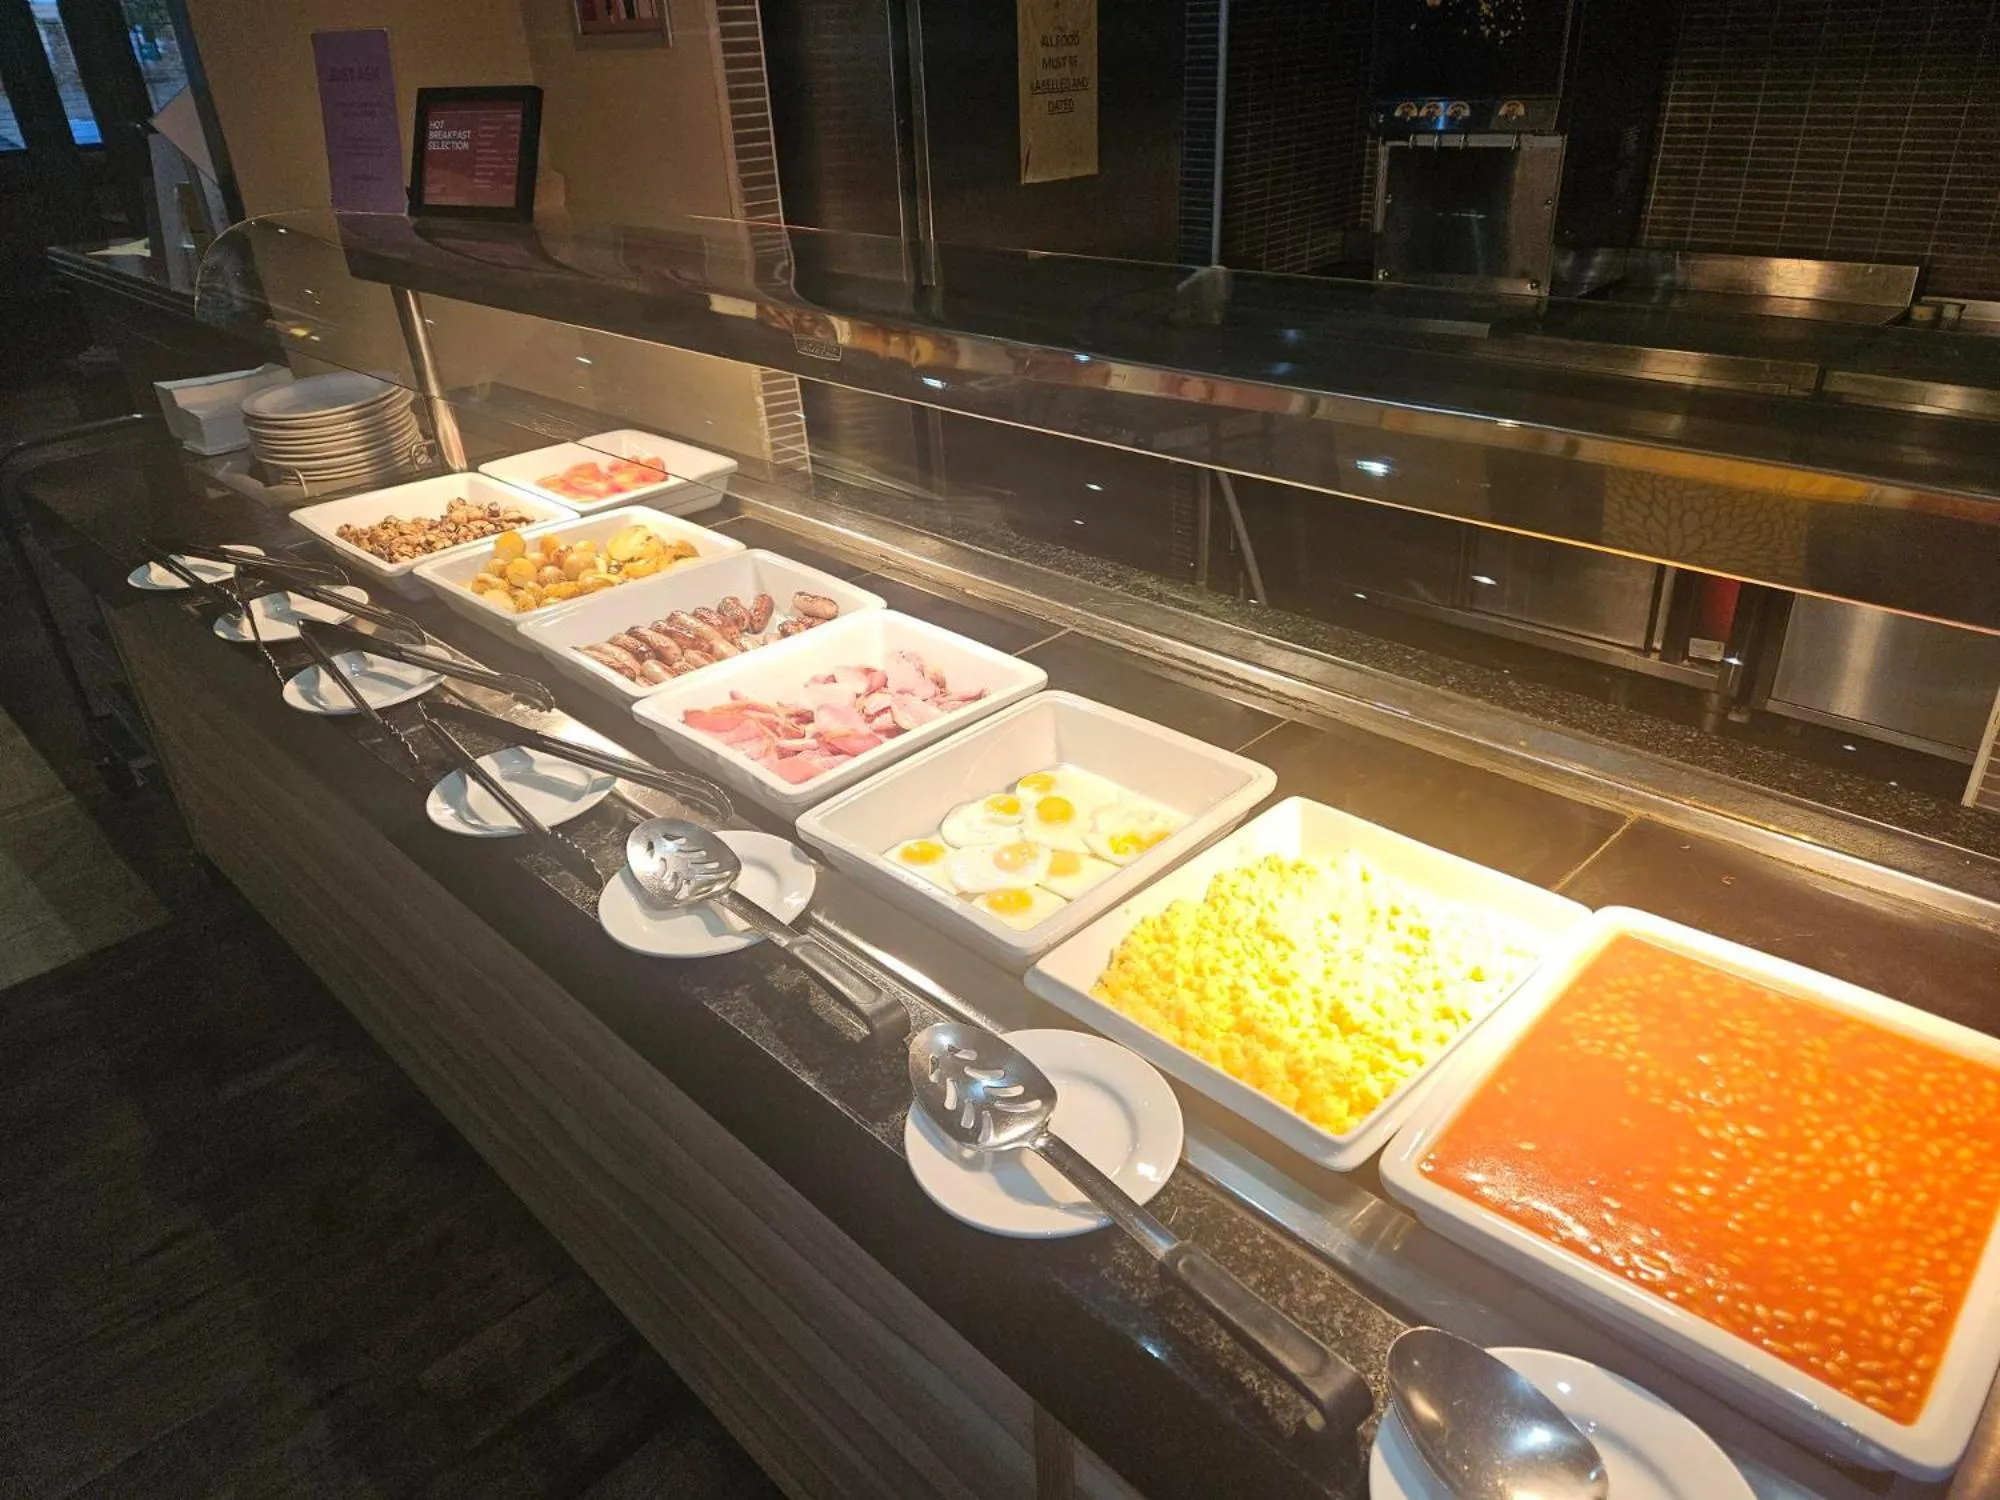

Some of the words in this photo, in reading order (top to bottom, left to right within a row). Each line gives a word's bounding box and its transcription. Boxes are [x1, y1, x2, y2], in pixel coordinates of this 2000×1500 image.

[1040, 35, 1056, 48] ALL
[1057, 33, 1080, 47] FOOD
[1042, 55, 1066, 70] MUST
[1069, 55, 1079, 68] BE
[1071, 76, 1089, 90] AND
[1047, 98, 1075, 112] DATED
[429, 119, 445, 130] HOT
[429, 130, 471, 140] BREAKFAST
[428, 140, 470, 150] SELECTION
